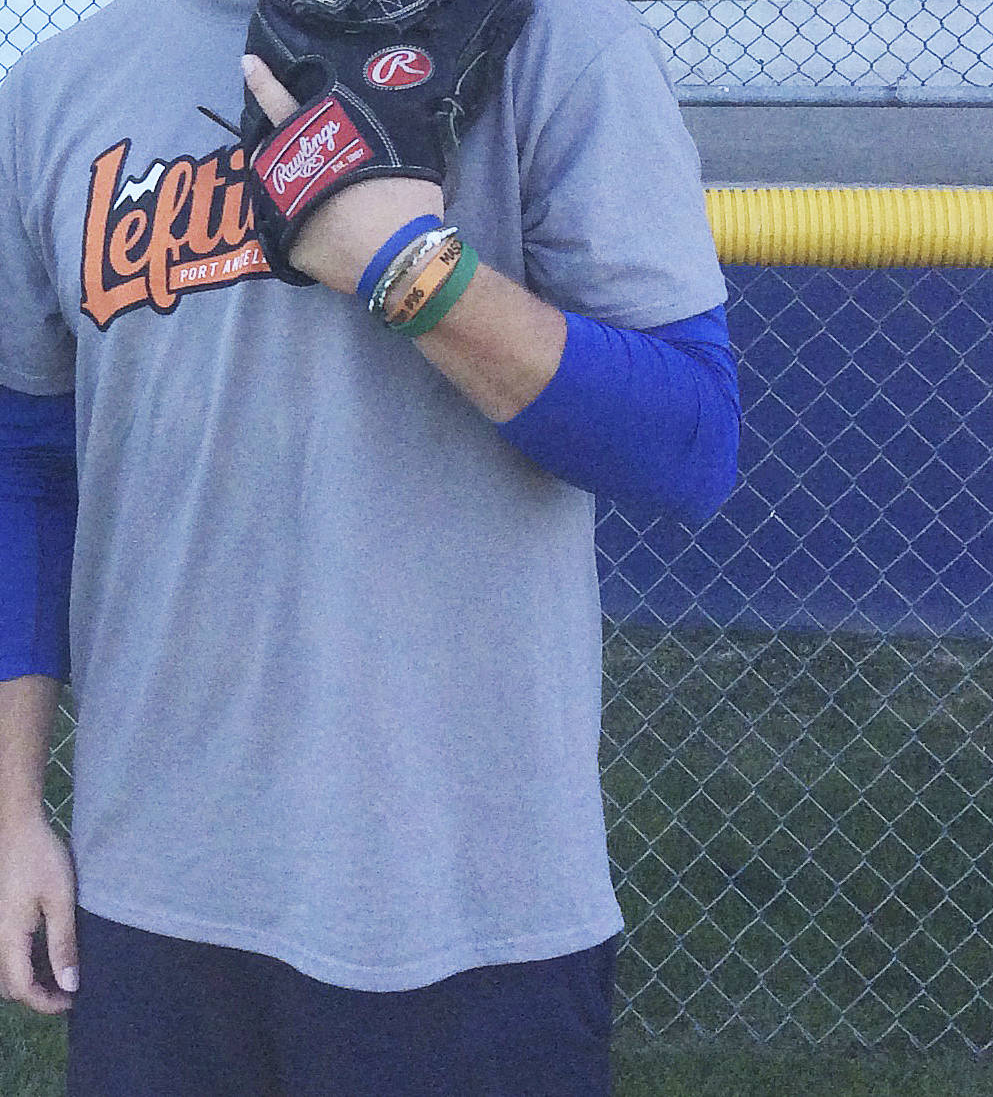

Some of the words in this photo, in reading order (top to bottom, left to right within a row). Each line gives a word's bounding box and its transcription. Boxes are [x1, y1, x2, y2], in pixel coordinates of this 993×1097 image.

[371, 49, 425, 84] R
[272, 120, 341, 195] Rawlings
[80, 137, 255, 332] Lefti
[180, 261, 220, 283] PORT
[222, 247, 268, 275] ANEL
